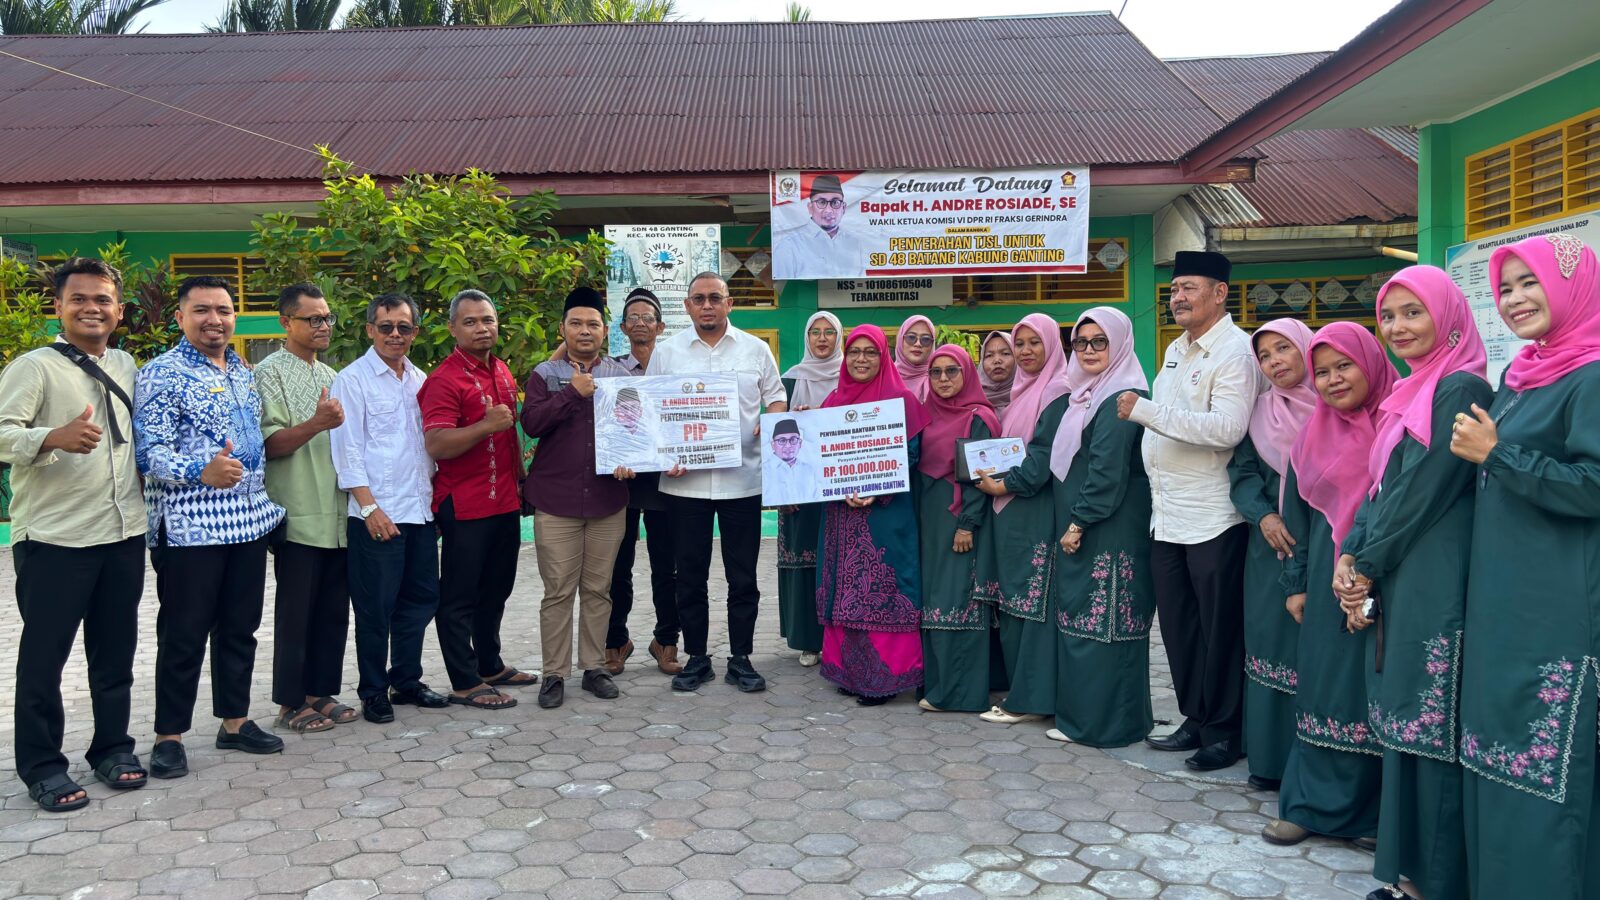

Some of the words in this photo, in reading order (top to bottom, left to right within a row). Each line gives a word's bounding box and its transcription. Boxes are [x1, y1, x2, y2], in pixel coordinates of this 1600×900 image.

[884, 178, 966, 195] Selamat
[972, 177, 1053, 193] Datang
[860, 200, 910, 216] Bapak
[912, 200, 929, 212] H.
[931, 199, 982, 211] ANDRE
[985, 197, 1056, 211] ROSIADE,
[1059, 197, 1077, 209] SE
[869, 218, 896, 226] WAKIL
[897, 217, 924, 225] KETUA
[925, 217, 955, 225] KOMISI
[956, 216, 965, 224] VI
[995, 215, 1023, 223] FRAKSI
[1027, 214, 1068, 222] GERINDRA
[889, 235, 972, 251] PENYERAHAN
[974, 234, 1001, 249] TJSL
[1003, 234, 1045, 248] UNTUK
[1477, 237, 1506, 250] REKAPITULASI
[1560, 223, 1575, 232] DANA
[1575, 219, 1589, 228] BOSP
[642, 243, 684, 265] ADIWIYATA
[870, 252, 887, 266] SD
[889, 252, 906, 265] 48
[908, 251, 956, 265] BATANG
[958, 249, 1009, 264] KABUNG
[1010, 248, 1065, 263] GANTING
[837, 281, 855, 290] NSS
[865, 279, 933, 289] 101086105048
[851, 291, 919, 302] TERAKREDITASI
[683, 423, 707, 441] PIP
[819, 429, 851, 438] PENYALURAN
[852, 425, 876, 434] BANTUAN
[888, 422, 904, 430] BUMN
[821, 444, 829, 453] H.
[830, 441, 856, 452] ANDRE
[893, 435, 904, 444] SE
[688, 453, 716, 464] SISWA
[823, 466, 837, 478] RP.
[838, 459, 903, 476] 100.000.000,-
[822, 488, 833, 497] SDN
[861, 482, 882, 493] KABUNG
[883, 480, 906, 490] GANTING
